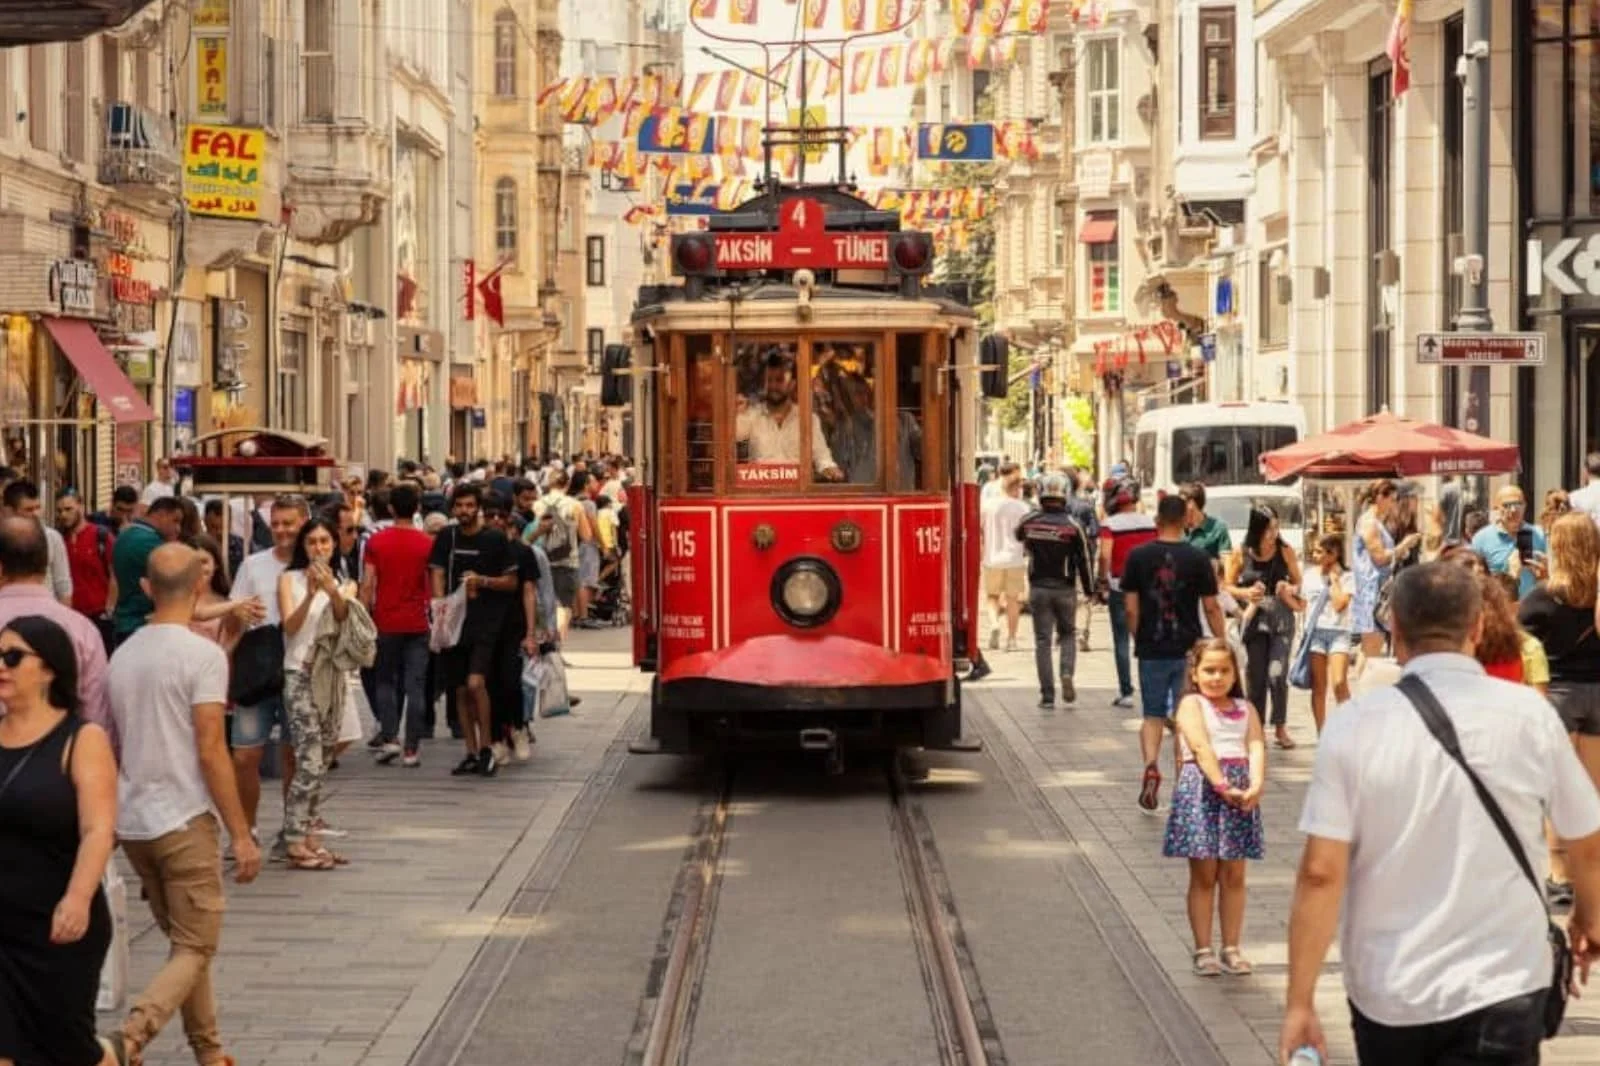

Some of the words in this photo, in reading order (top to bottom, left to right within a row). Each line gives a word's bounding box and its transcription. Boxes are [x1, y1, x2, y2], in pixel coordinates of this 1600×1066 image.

[190, 129, 257, 161] FAL
[791, 200, 807, 229] 4
[716, 235, 773, 263] AKSİM
[738, 466, 798, 481] TAKSİM
[669, 530, 697, 557] 115
[915, 526, 941, 554] 115
